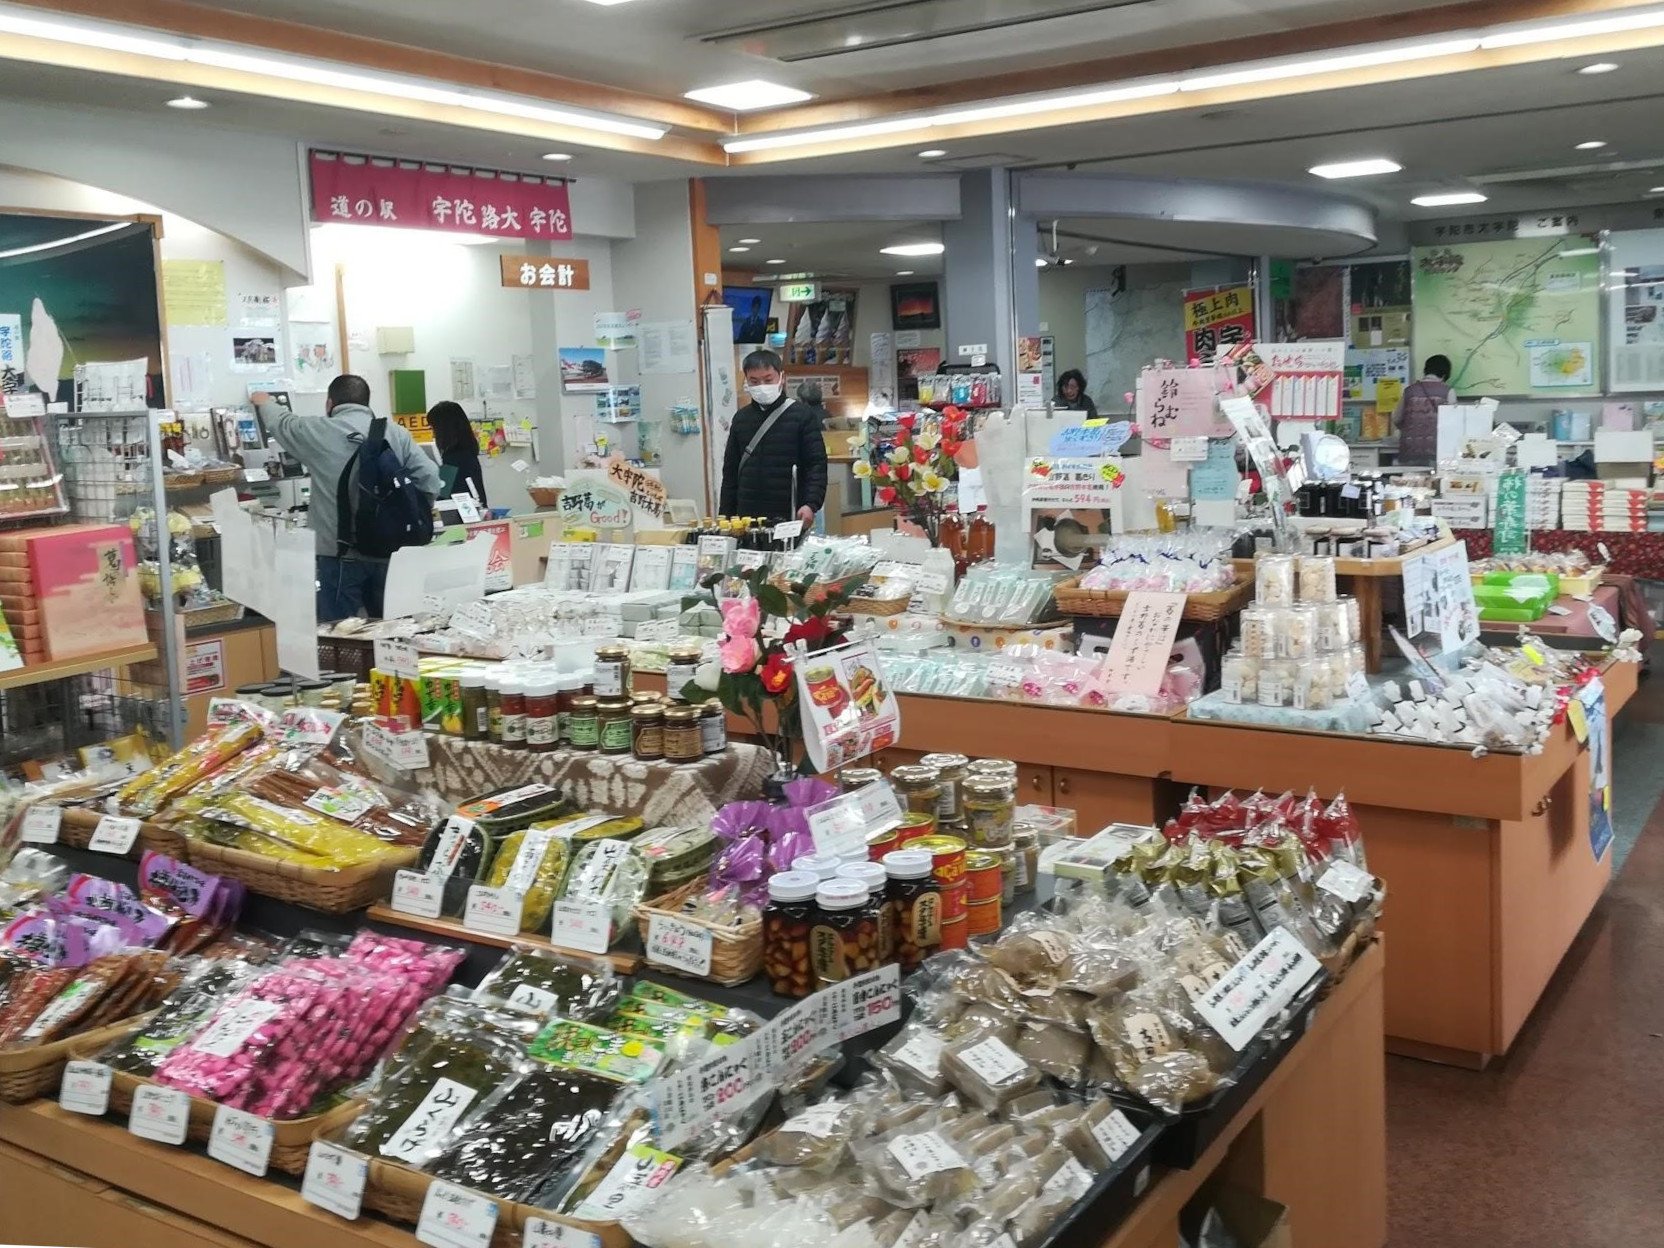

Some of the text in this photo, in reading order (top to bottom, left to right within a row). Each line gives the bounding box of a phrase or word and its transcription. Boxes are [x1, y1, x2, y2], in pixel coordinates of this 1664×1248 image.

[330, 196, 398, 222] 道の駅
[519, 262, 575, 287] お会計
[1191, 291, 1240, 318] 極上肉
